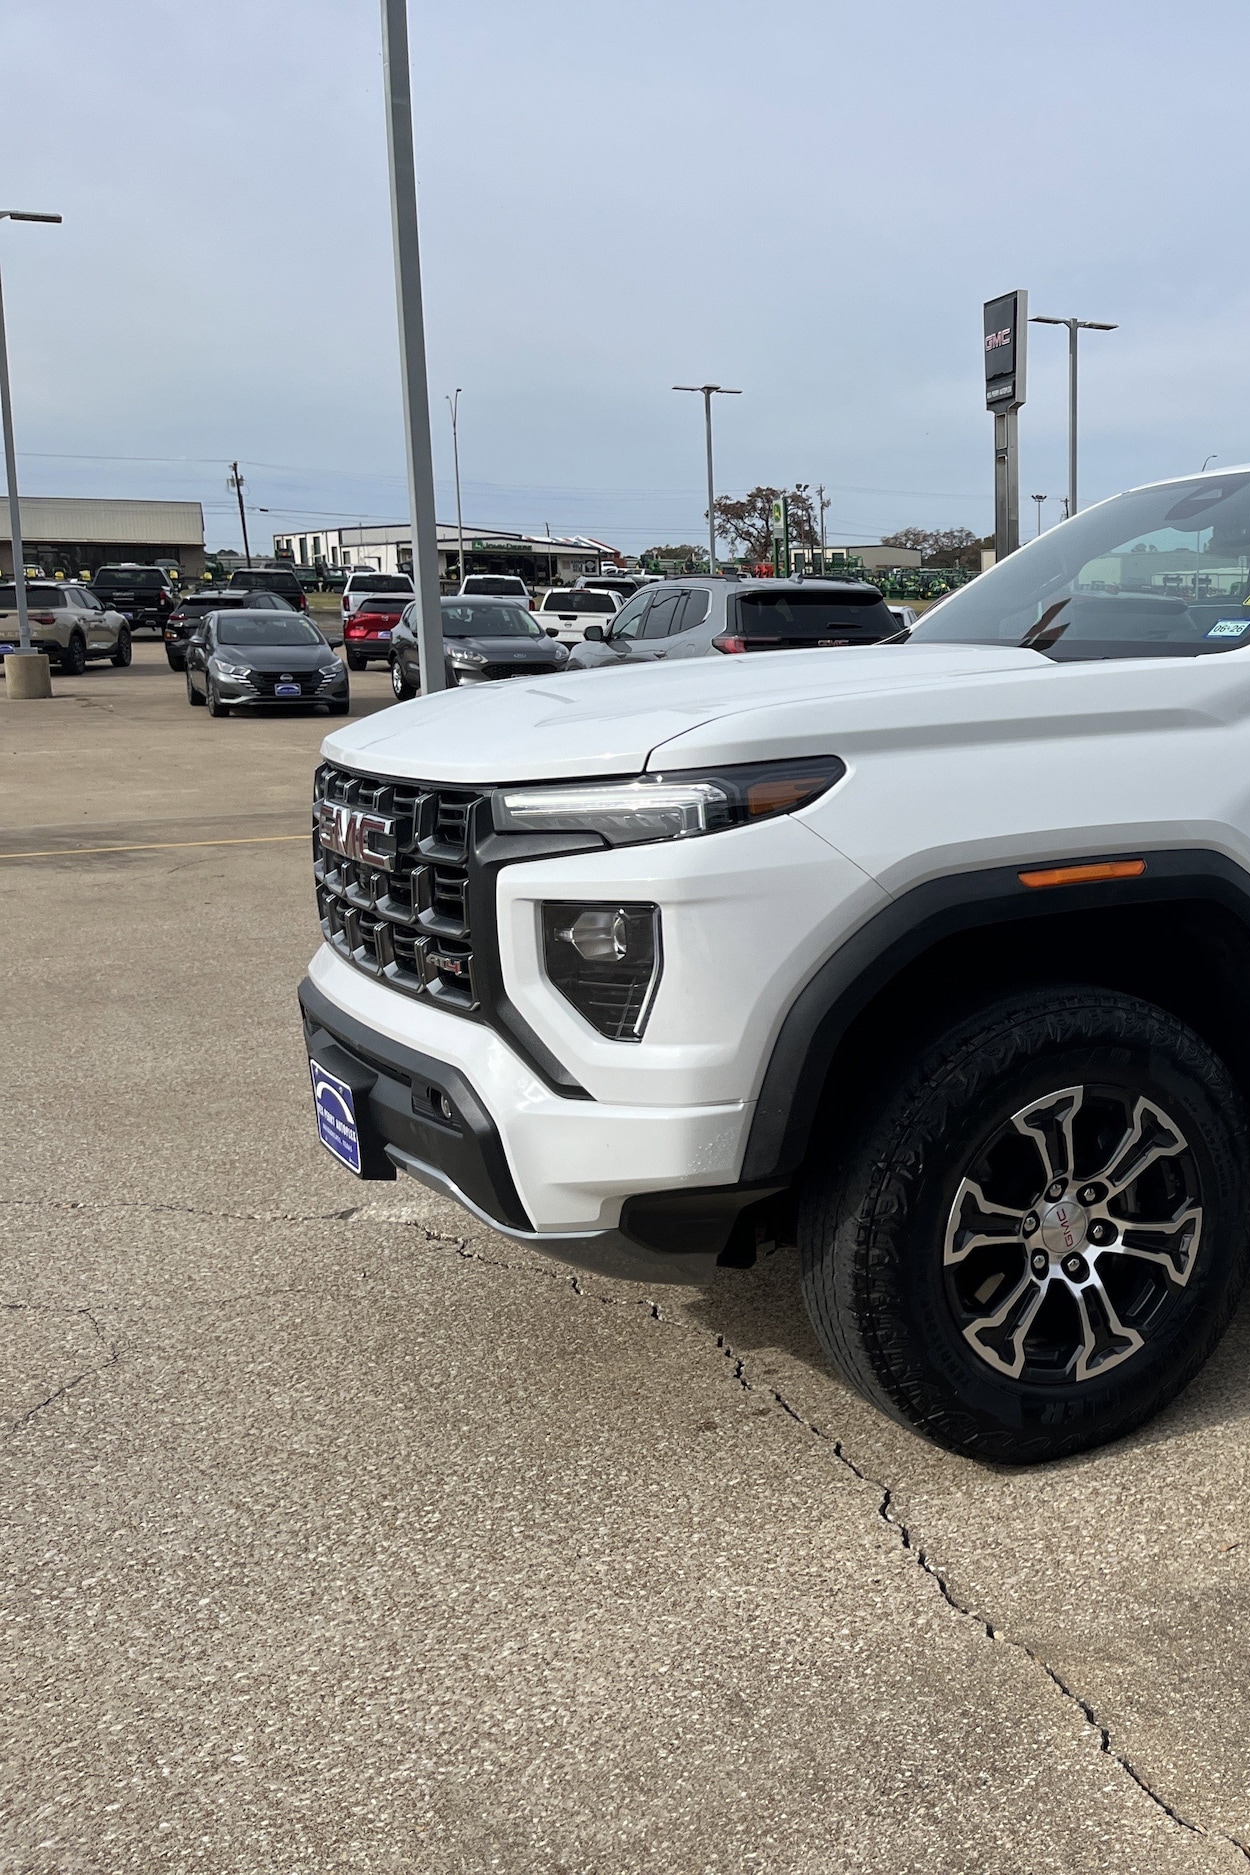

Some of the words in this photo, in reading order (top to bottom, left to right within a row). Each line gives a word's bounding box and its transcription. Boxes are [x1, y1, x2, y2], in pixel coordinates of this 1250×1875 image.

[985, 327, 1011, 351] GMC
[1229, 625, 1245, 633] 26
[318, 799, 397, 872] GMC
[425, 953, 462, 976] AT4
[1056, 1208, 1074, 1248] GMC
